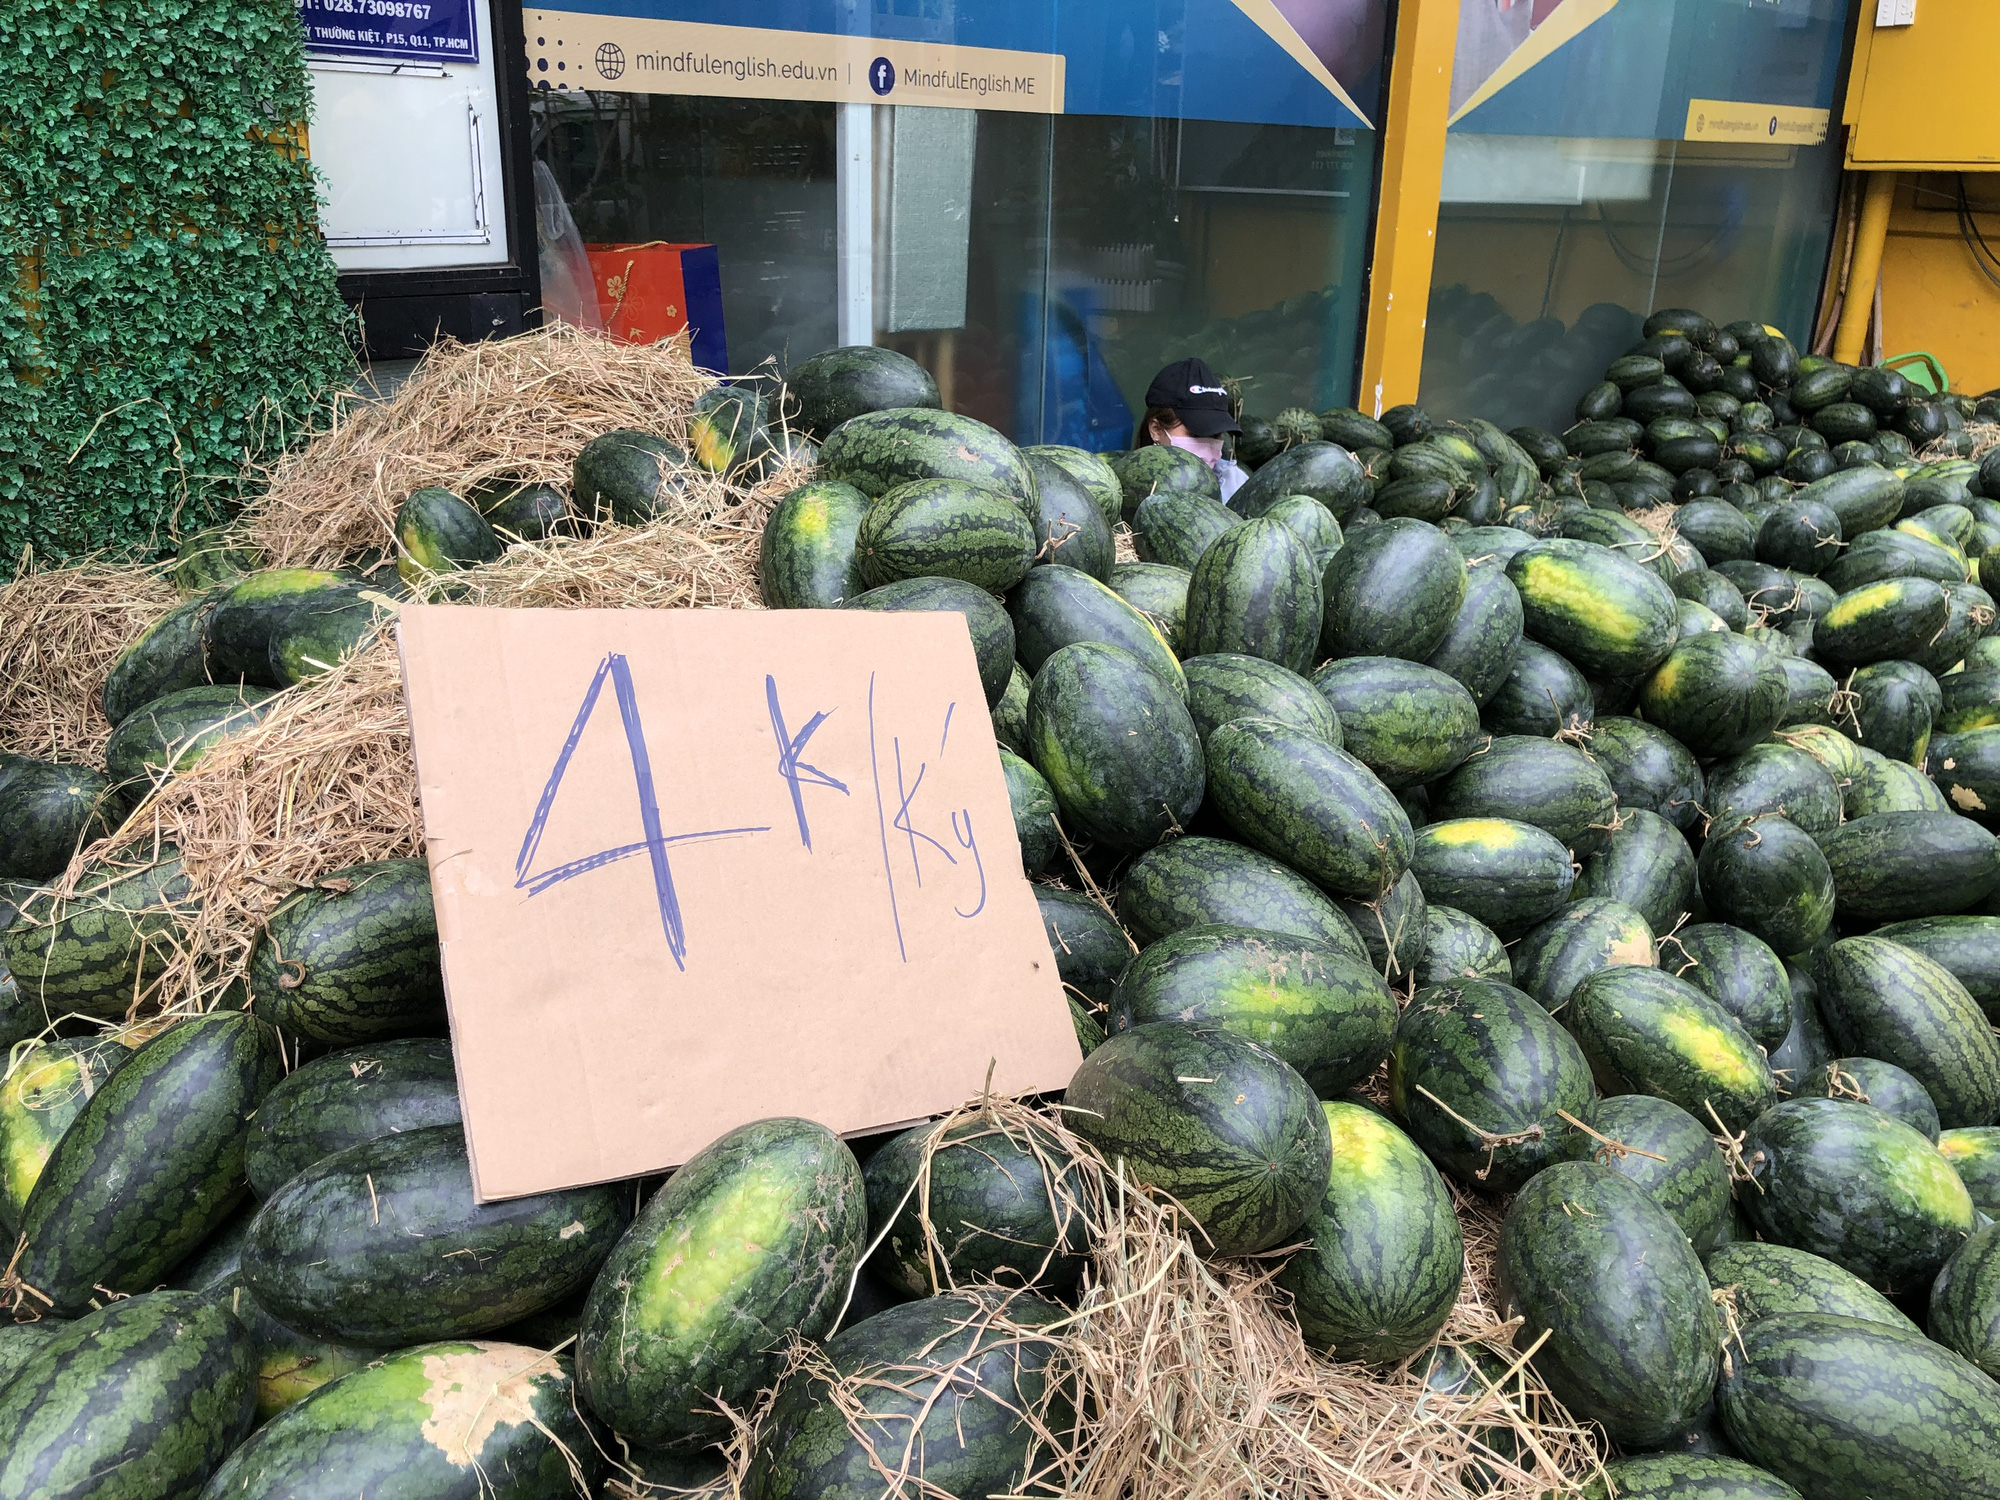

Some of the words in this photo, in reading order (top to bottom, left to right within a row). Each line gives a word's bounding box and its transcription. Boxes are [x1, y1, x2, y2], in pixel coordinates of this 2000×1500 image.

[324, 0, 431, 20] 028.73098767
[314, 26, 356, 41] THƯỜNG
[357, 28, 384, 45] KIỆT,
[386, 32, 408, 47] P15,
[409, 34, 432, 48] Q11,
[433, 36, 469, 50] TP.HCM
[636, 50, 838, 82] mindfulenglish.edu.vn
[904, 68, 1036, 96] MindfulEnglish.ME
